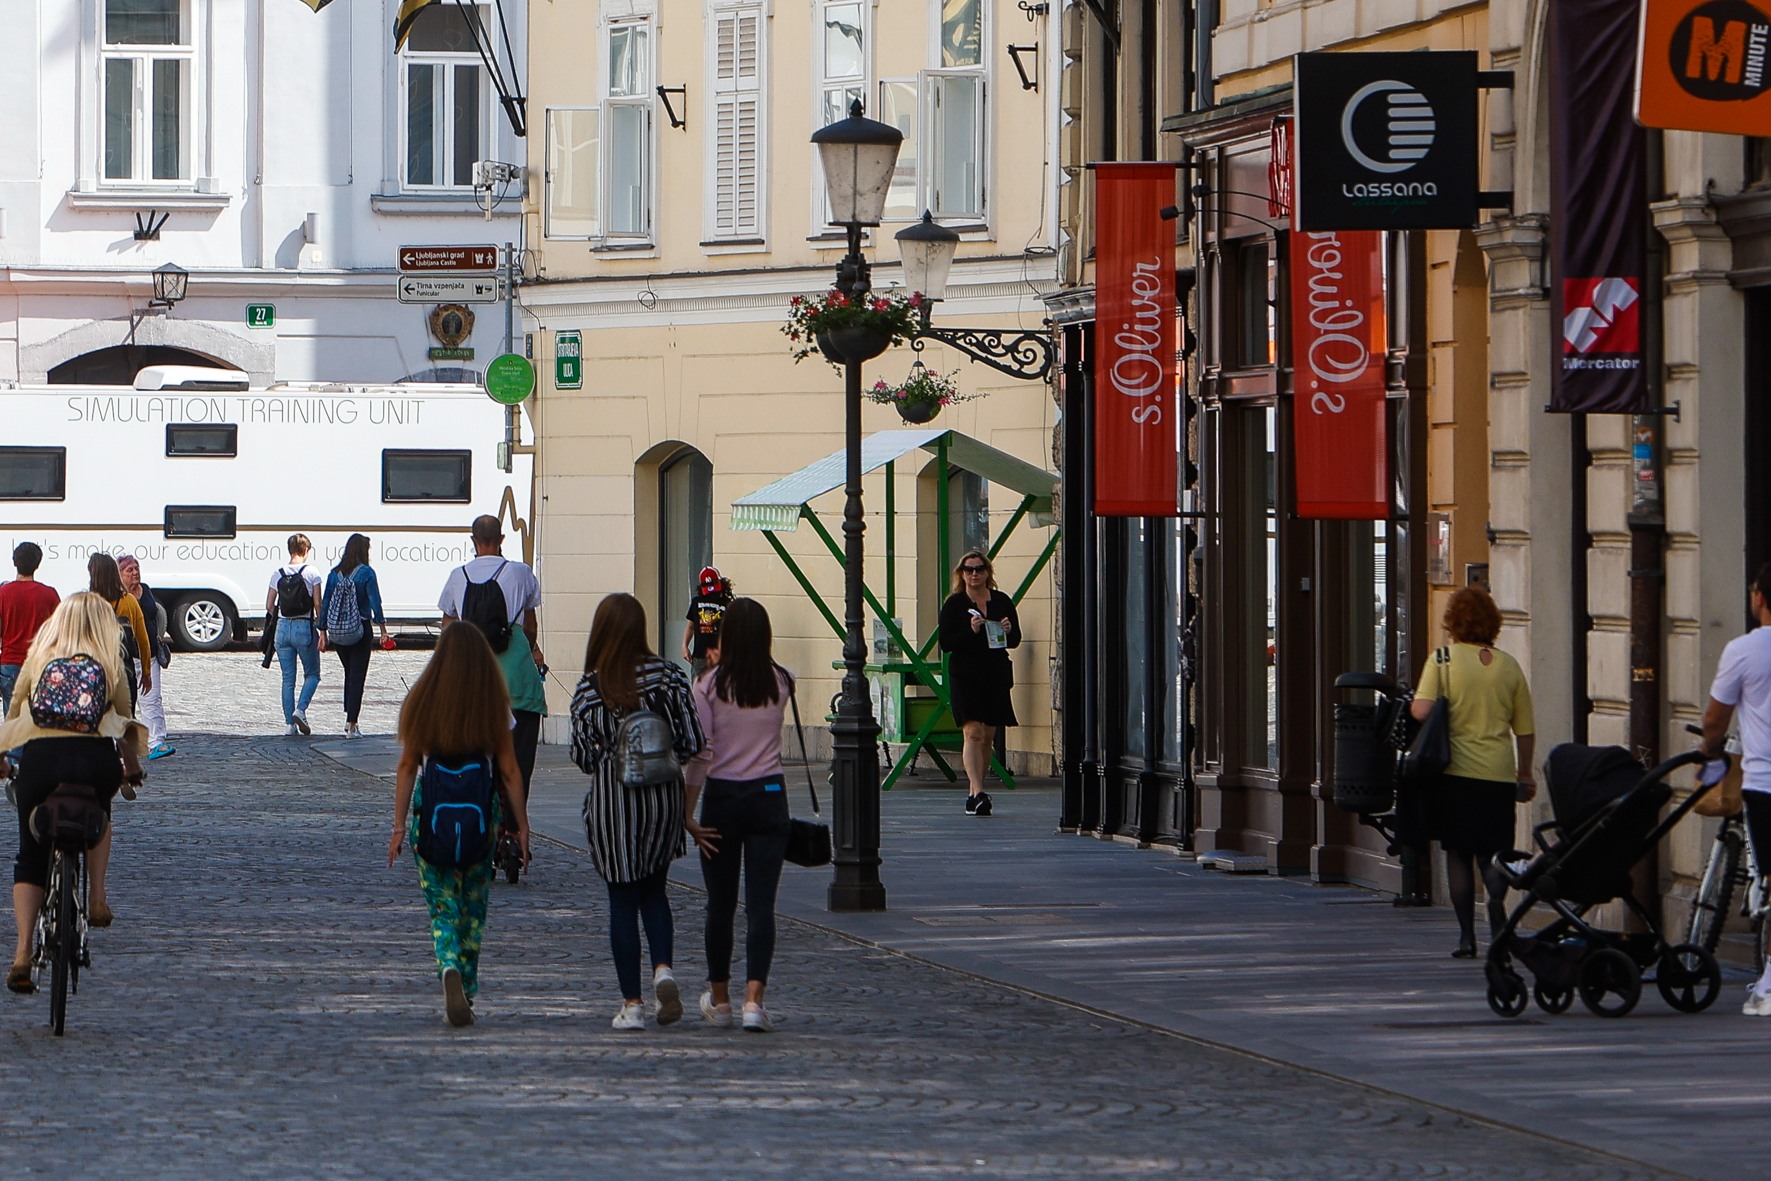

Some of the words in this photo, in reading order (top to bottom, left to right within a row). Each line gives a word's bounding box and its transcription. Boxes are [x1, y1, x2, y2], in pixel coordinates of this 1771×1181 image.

[1743, 22, 1769, 88] MINUTE
[415, 251, 449, 260] Ljubljanski
[449, 251, 465, 260] grad
[415, 259, 439, 267] Ljubljana
[434, 282, 465, 290] vzpenjača
[256, 308, 266, 320] 27
[1109, 256, 1164, 425] s.Oliver
[1562, 357, 1641, 370] Mercator
[68, 397, 226, 423] SIMULATION
[237, 398, 358, 424] TRAINING
[369, 399, 426, 424] UNIT
[67, 539, 126, 560] make
[134, 543, 169, 561] our
[177, 538, 281, 561] education
[381, 540, 467, 562] location!
